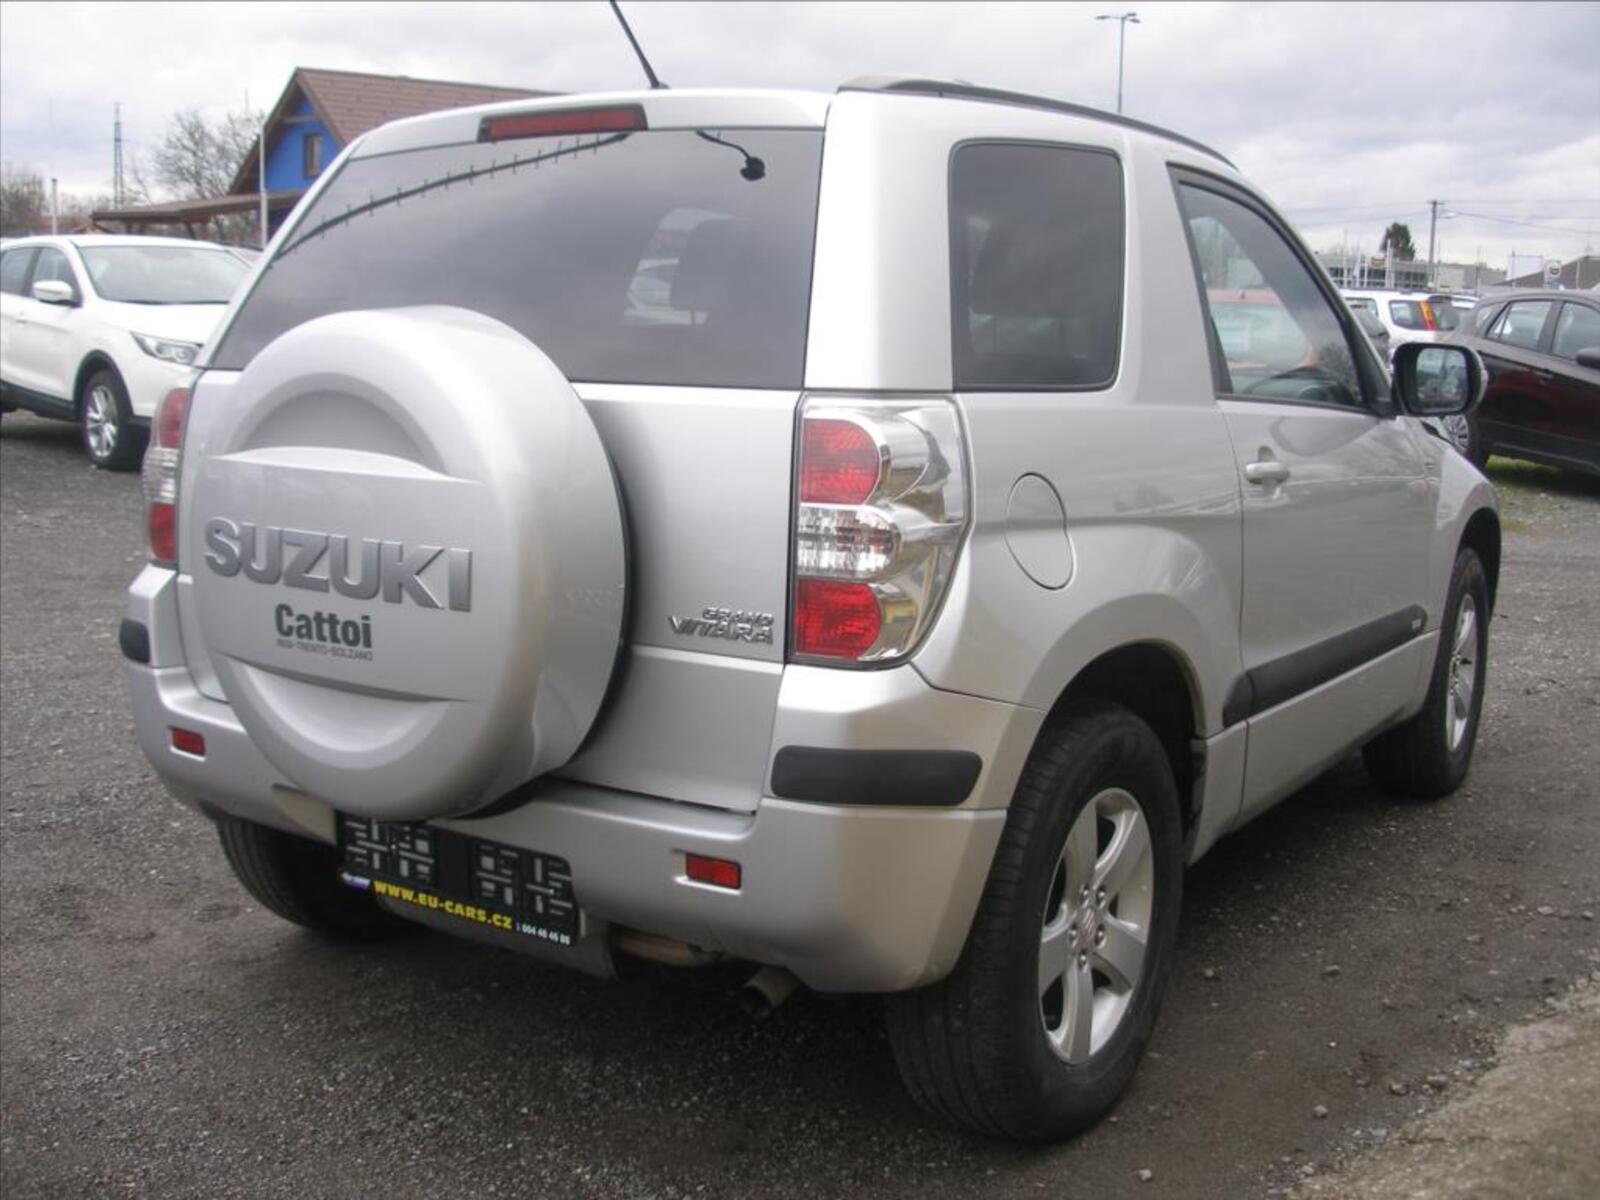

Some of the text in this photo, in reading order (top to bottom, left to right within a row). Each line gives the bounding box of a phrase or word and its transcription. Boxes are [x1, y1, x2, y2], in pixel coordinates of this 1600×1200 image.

[204, 516, 473, 613] SUZUKI
[275, 603, 373, 649] Cattoi
[667, 615, 774, 645] VITARA
[702, 607, 774, 626] GRAND
[373, 880, 513, 930] WWW.EU-CARS.CZ
